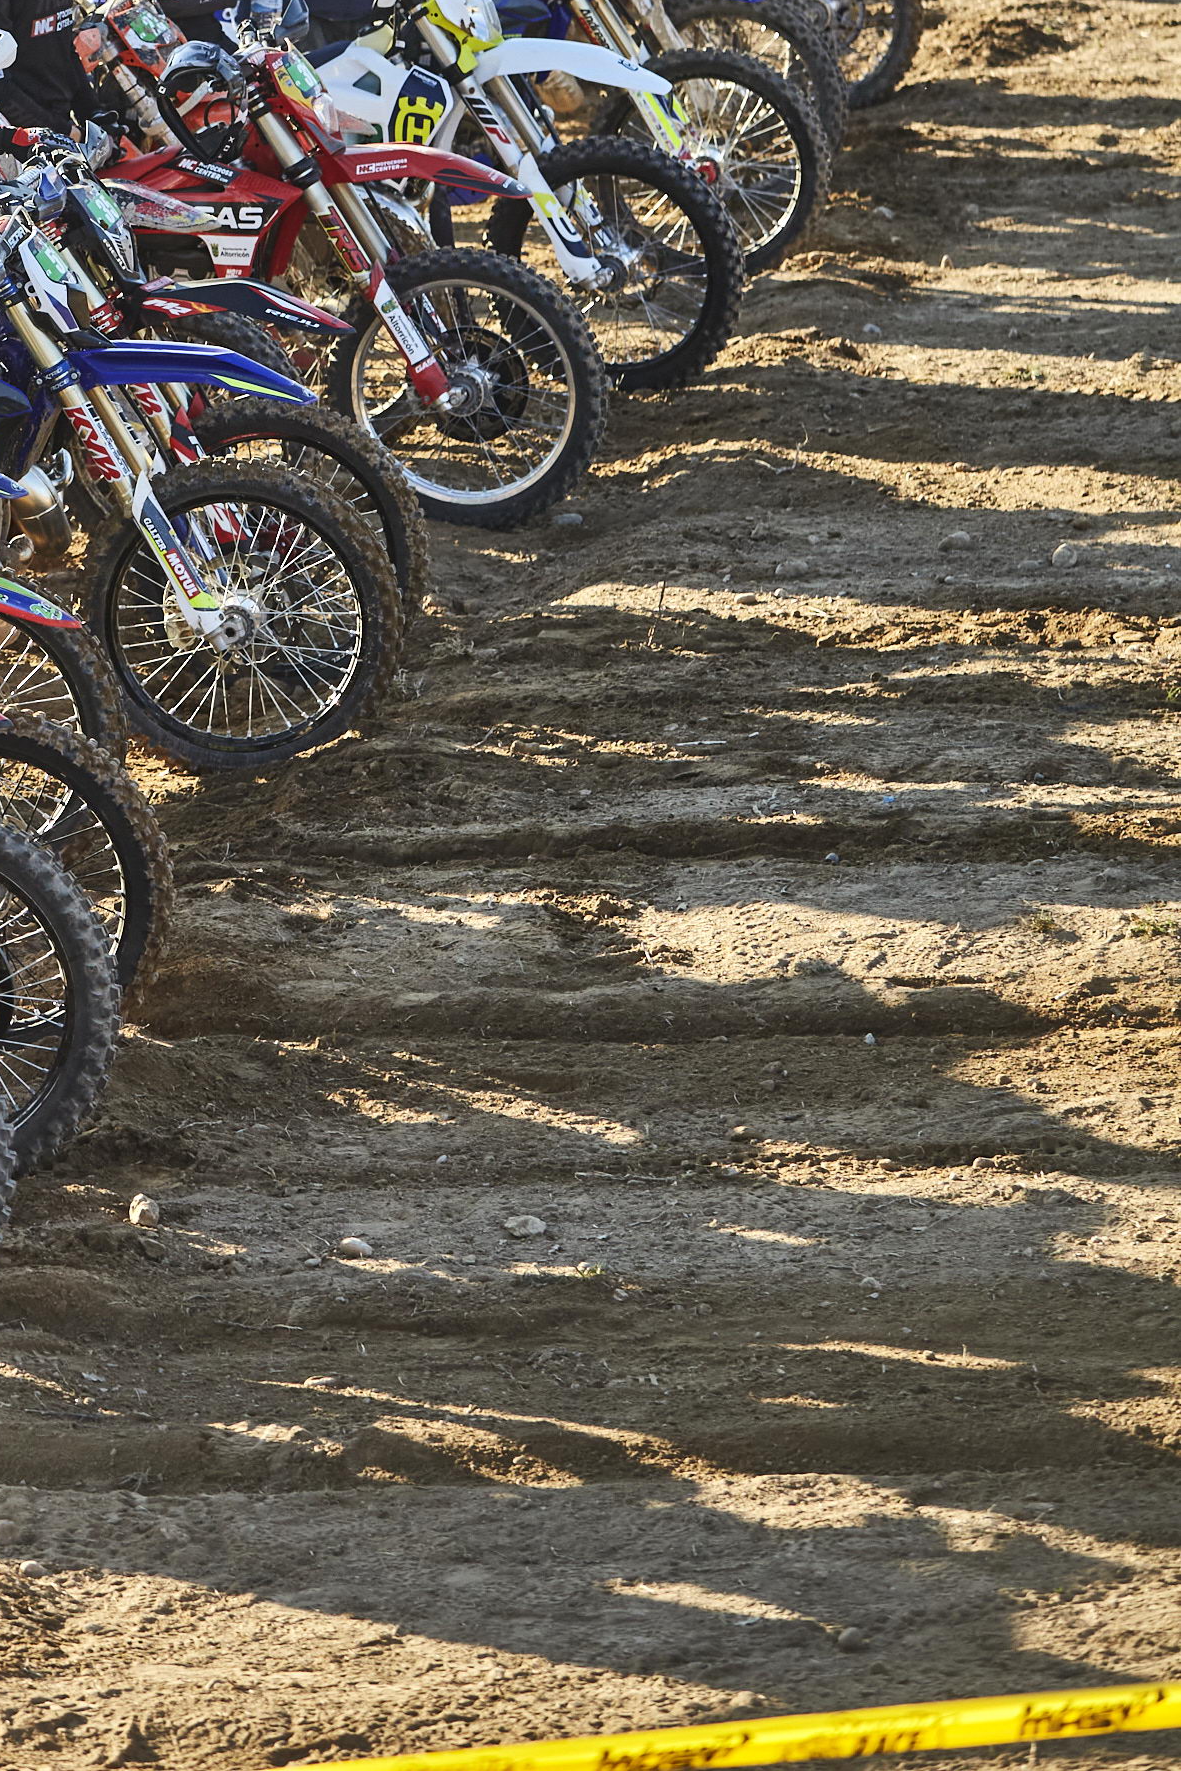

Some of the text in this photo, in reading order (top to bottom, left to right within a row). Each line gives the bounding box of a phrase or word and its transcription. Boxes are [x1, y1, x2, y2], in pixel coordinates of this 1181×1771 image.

[220, 250, 250, 259] Altorricón
[264, 307, 321, 330] RIEJU
[143, 517, 166, 552] GALFER
[166, 552, 198, 597] MOTUL
